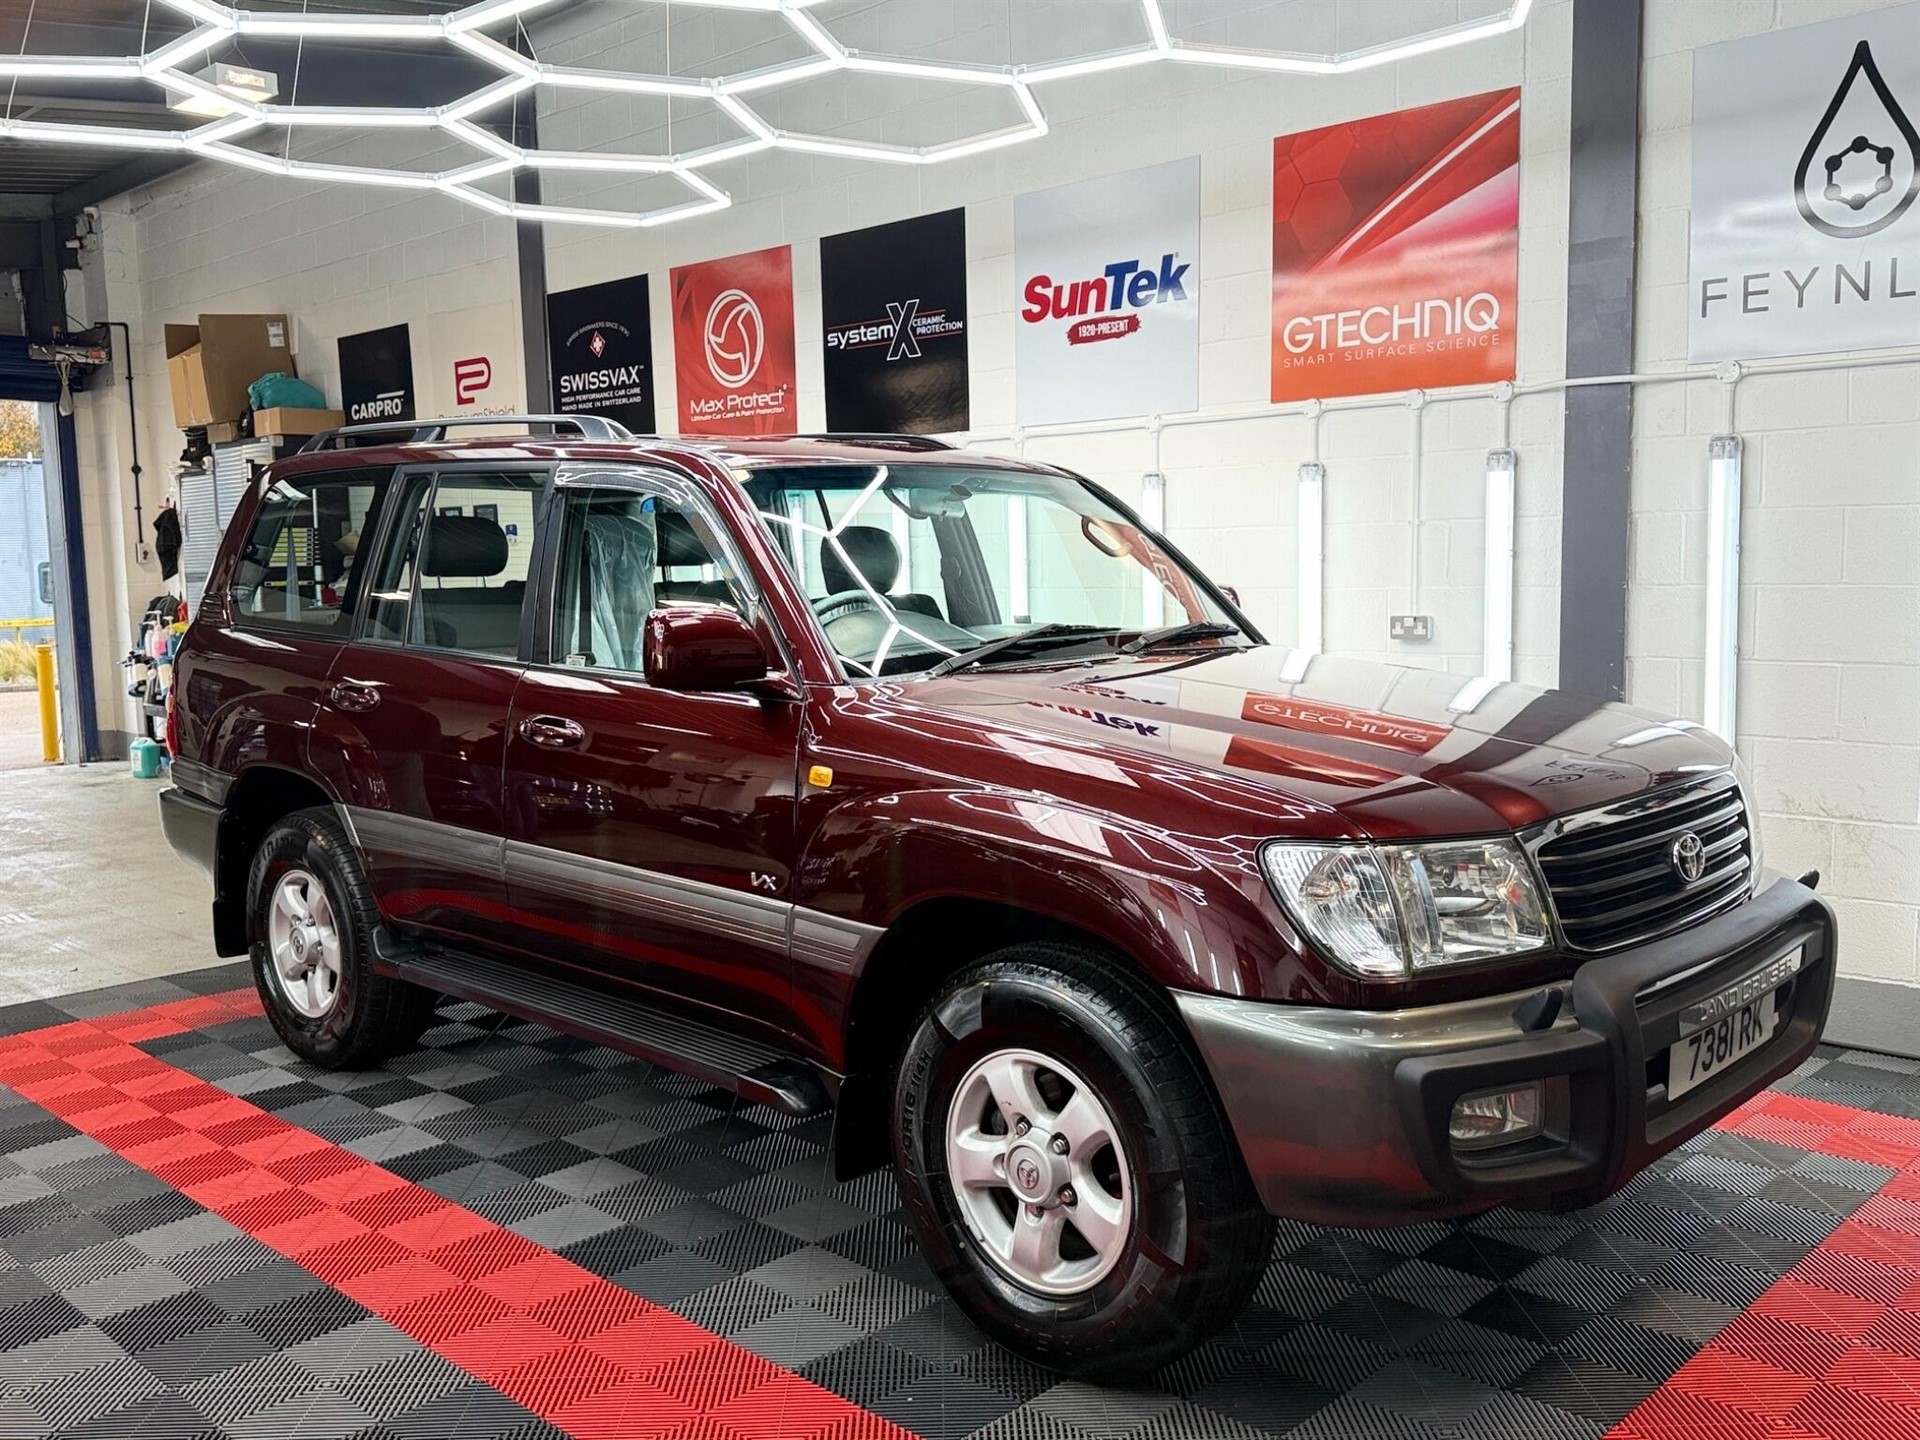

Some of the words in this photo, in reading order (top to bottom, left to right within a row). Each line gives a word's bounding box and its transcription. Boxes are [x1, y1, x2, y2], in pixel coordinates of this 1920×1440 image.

[1022, 254, 1190, 323] SunTek
[1701, 257, 1917, 318] FEYNL
[912, 314, 946, 327] CERAMIC
[916, 320, 963, 335] PROTECTION
[1078, 319, 1129, 338] 1920-PRESENT
[1283, 292, 1500, 354] GTECHNIQ
[1283, 353, 1335, 368] SMART
[1344, 344, 1416, 362] SURFACE
[1426, 334, 1500, 352] SCIENCE
[560, 365, 640, 393] SWISSVAX
[561, 403, 577, 412] HAND
[578, 401, 593, 409] MADE
[602, 396, 642, 407] SWITZERLAND
[576, 390, 614, 402] PERFORMANCE
[614, 389, 626, 398] CAR
[626, 387, 641, 395] CARE
[690, 399, 725, 414] Max
[727, 388, 785, 410] Protect
[351, 399, 402, 420] CARPRO
[750, 871, 777, 890] VX
[1739, 998, 1763, 1052] RK
